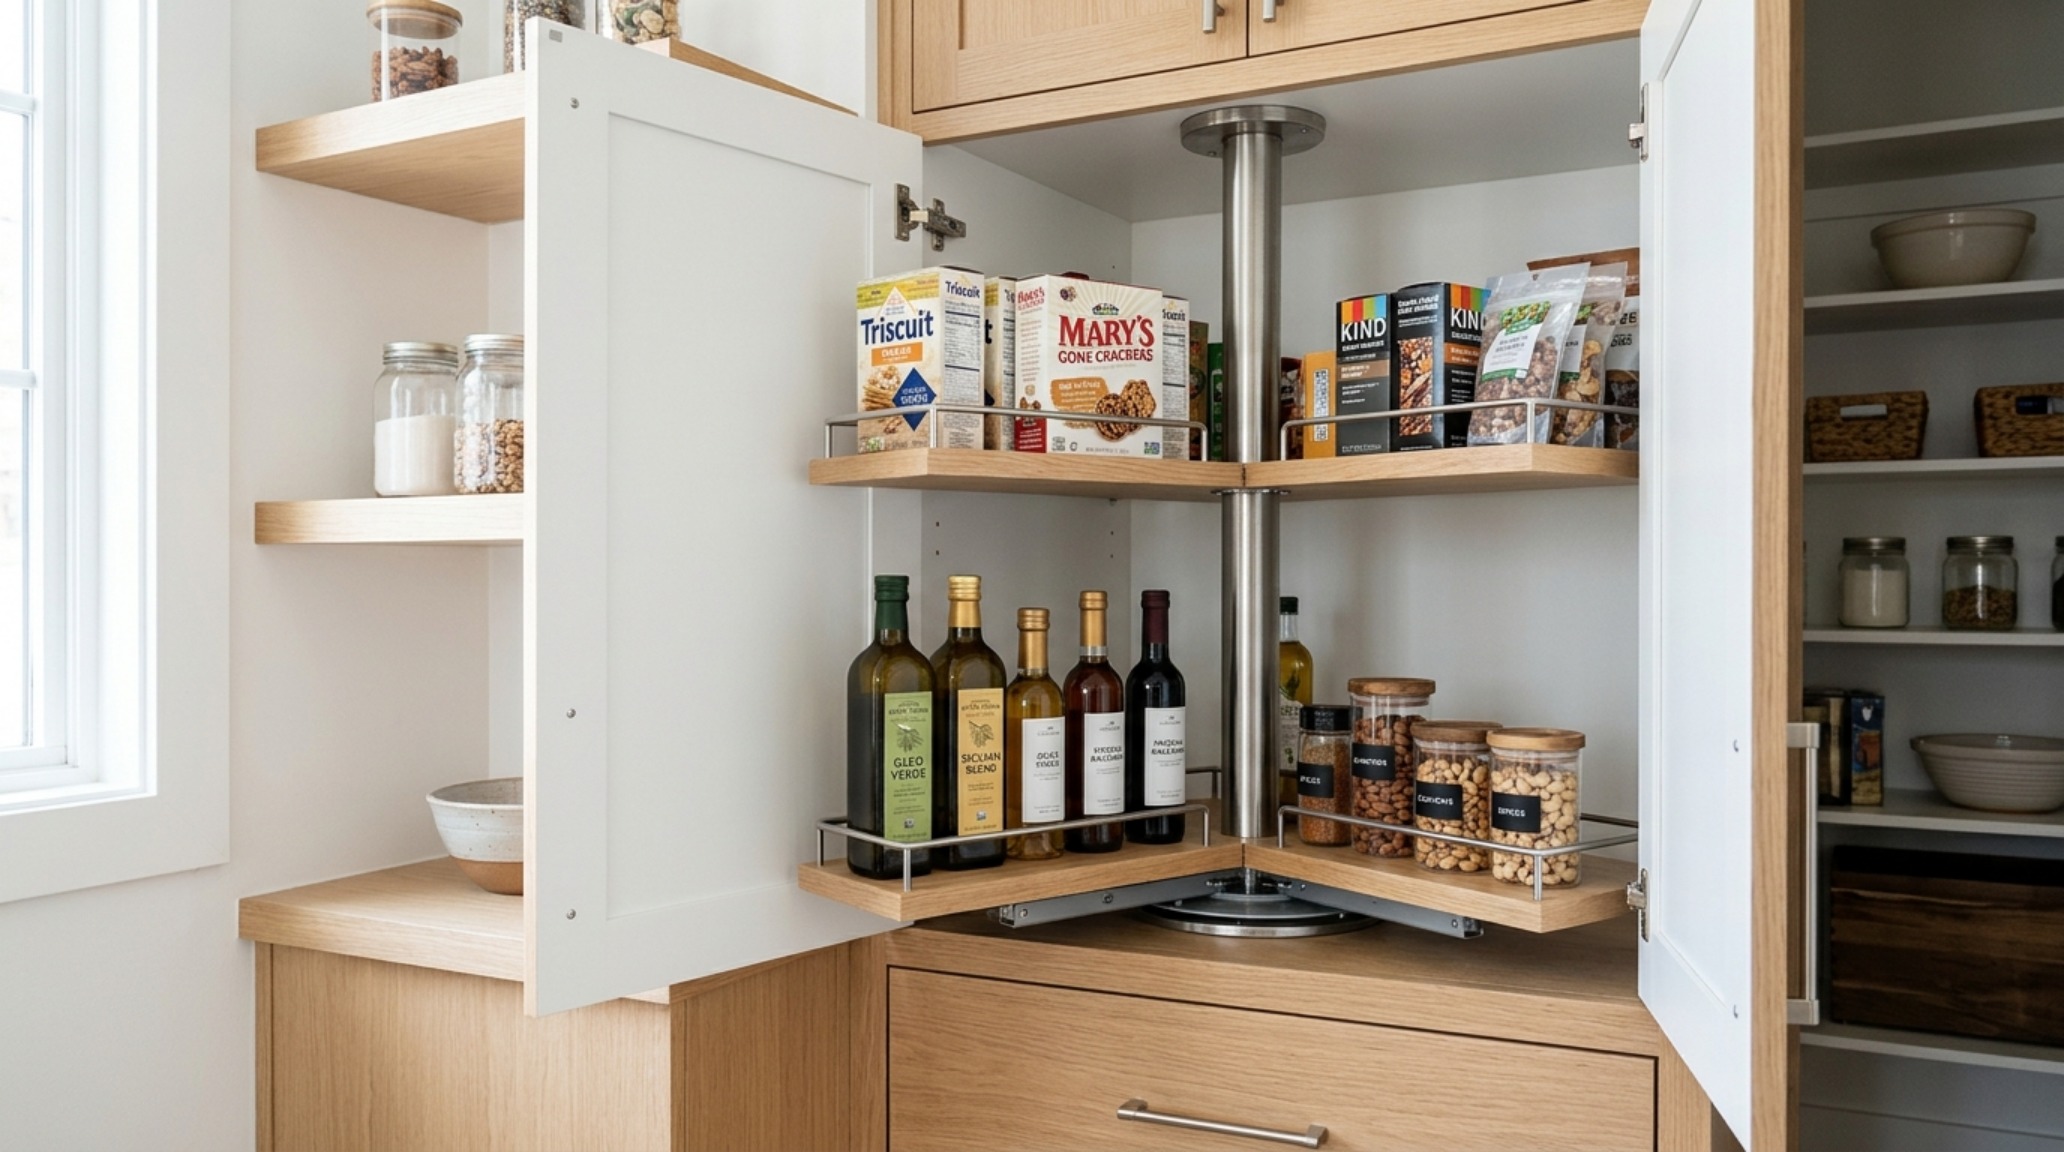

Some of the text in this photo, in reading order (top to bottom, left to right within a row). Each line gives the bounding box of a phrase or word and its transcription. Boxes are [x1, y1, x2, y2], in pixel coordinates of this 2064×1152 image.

[861, 310, 934, 345] Triscuit
[1058, 314, 1155, 347] MARY'S
[1341, 317, 1386, 342] KIND
[1058, 350, 1093, 364] GONE
[893, 755, 924, 768] GLEO
